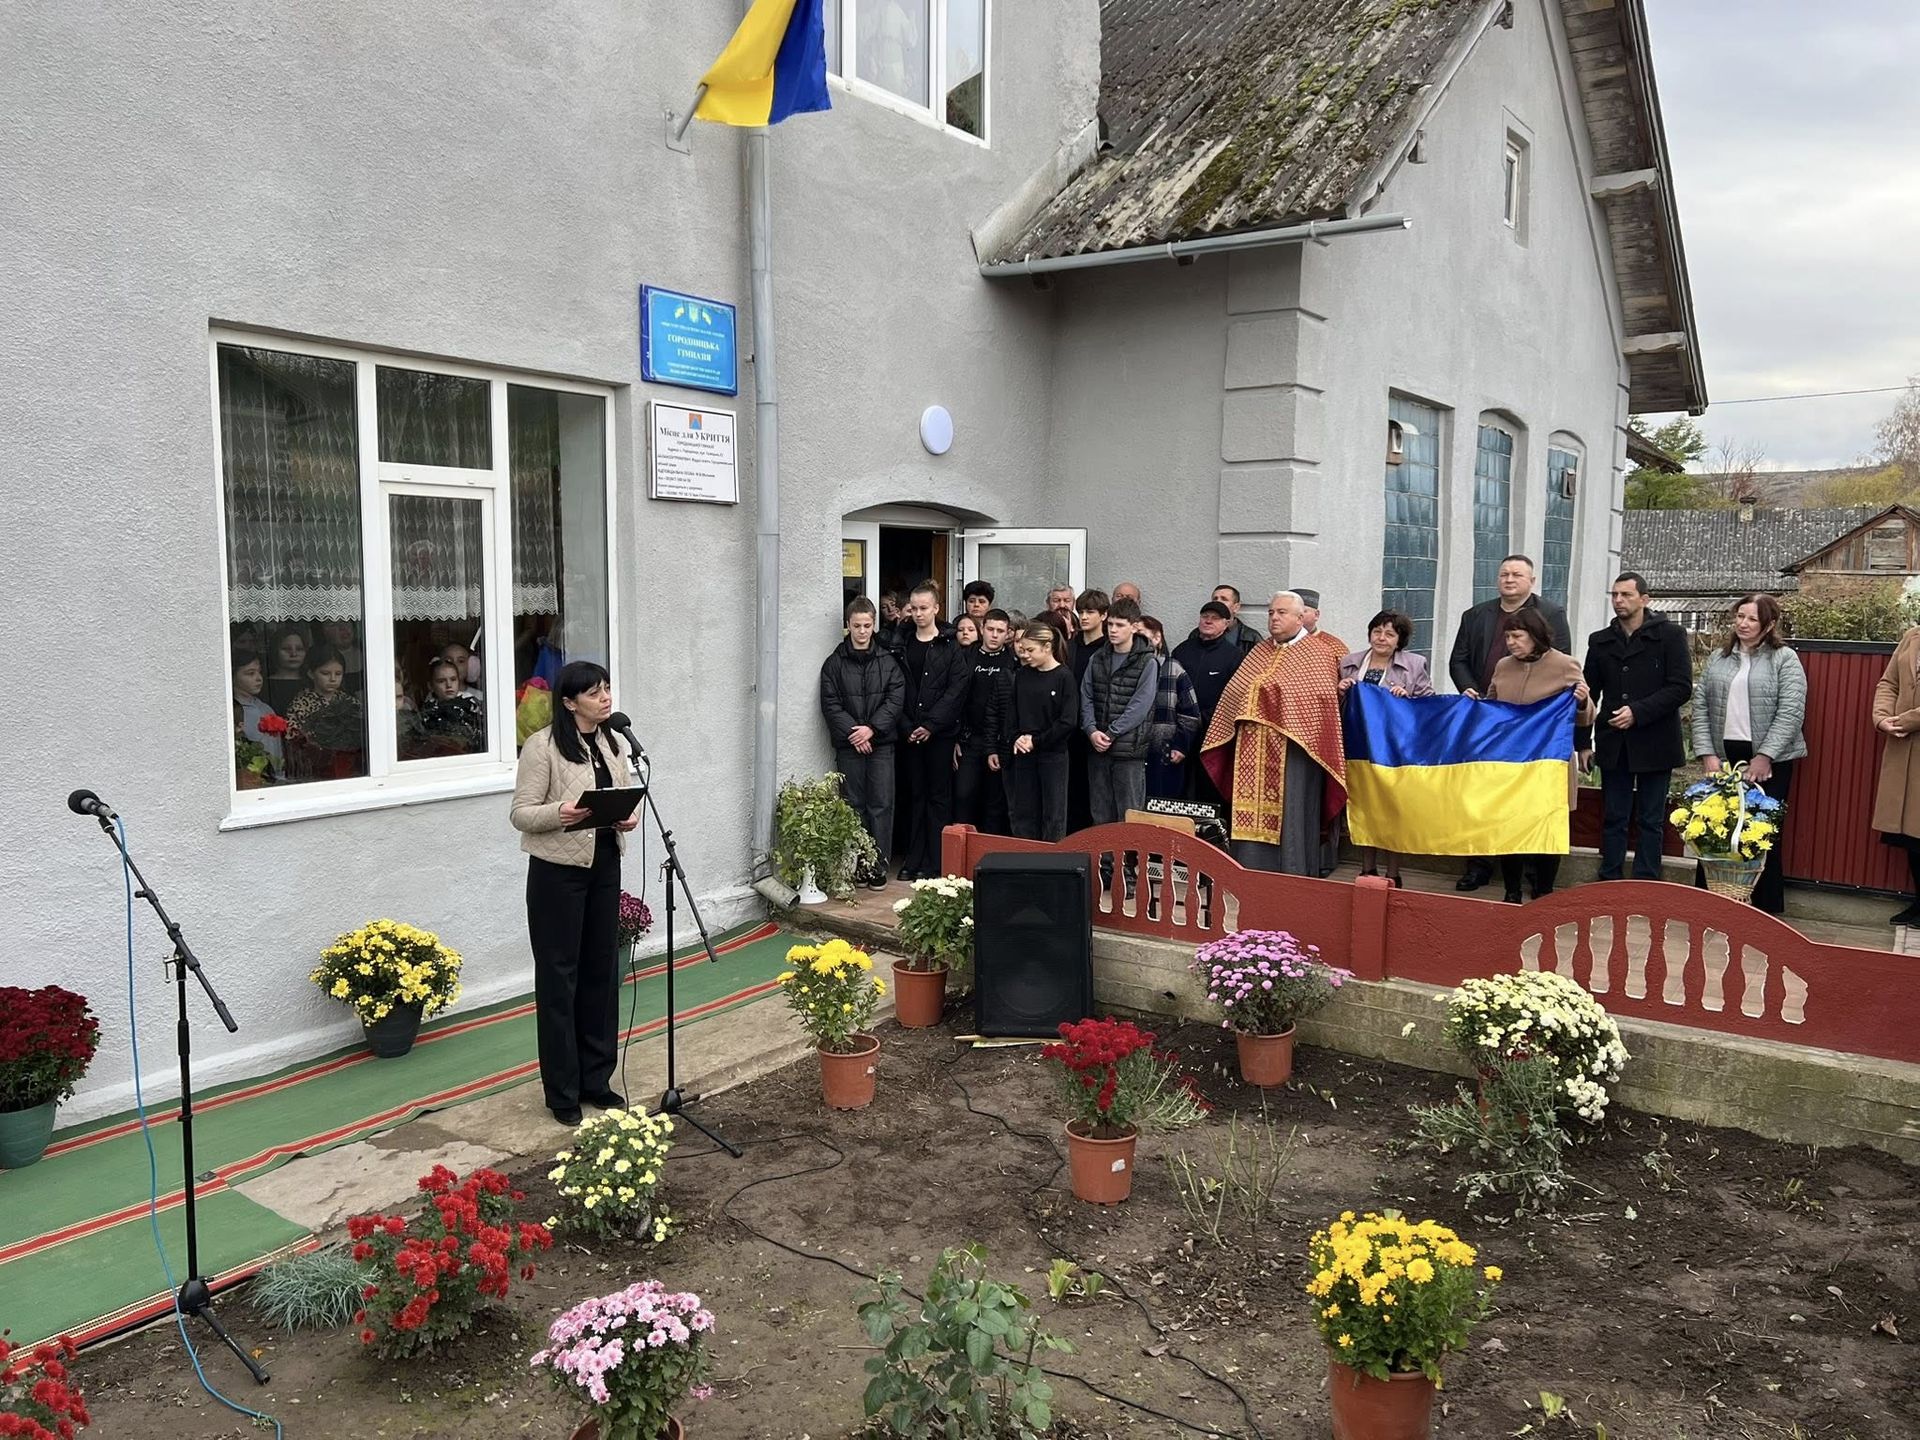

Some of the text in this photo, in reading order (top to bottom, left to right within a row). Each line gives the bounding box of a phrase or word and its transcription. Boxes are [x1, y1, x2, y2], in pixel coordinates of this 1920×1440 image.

[677, 348, 712, 362] ГІМНАЗІЯ
[660, 426, 680, 437] Місце
[695, 431, 731, 444] УКРИТТЯ
